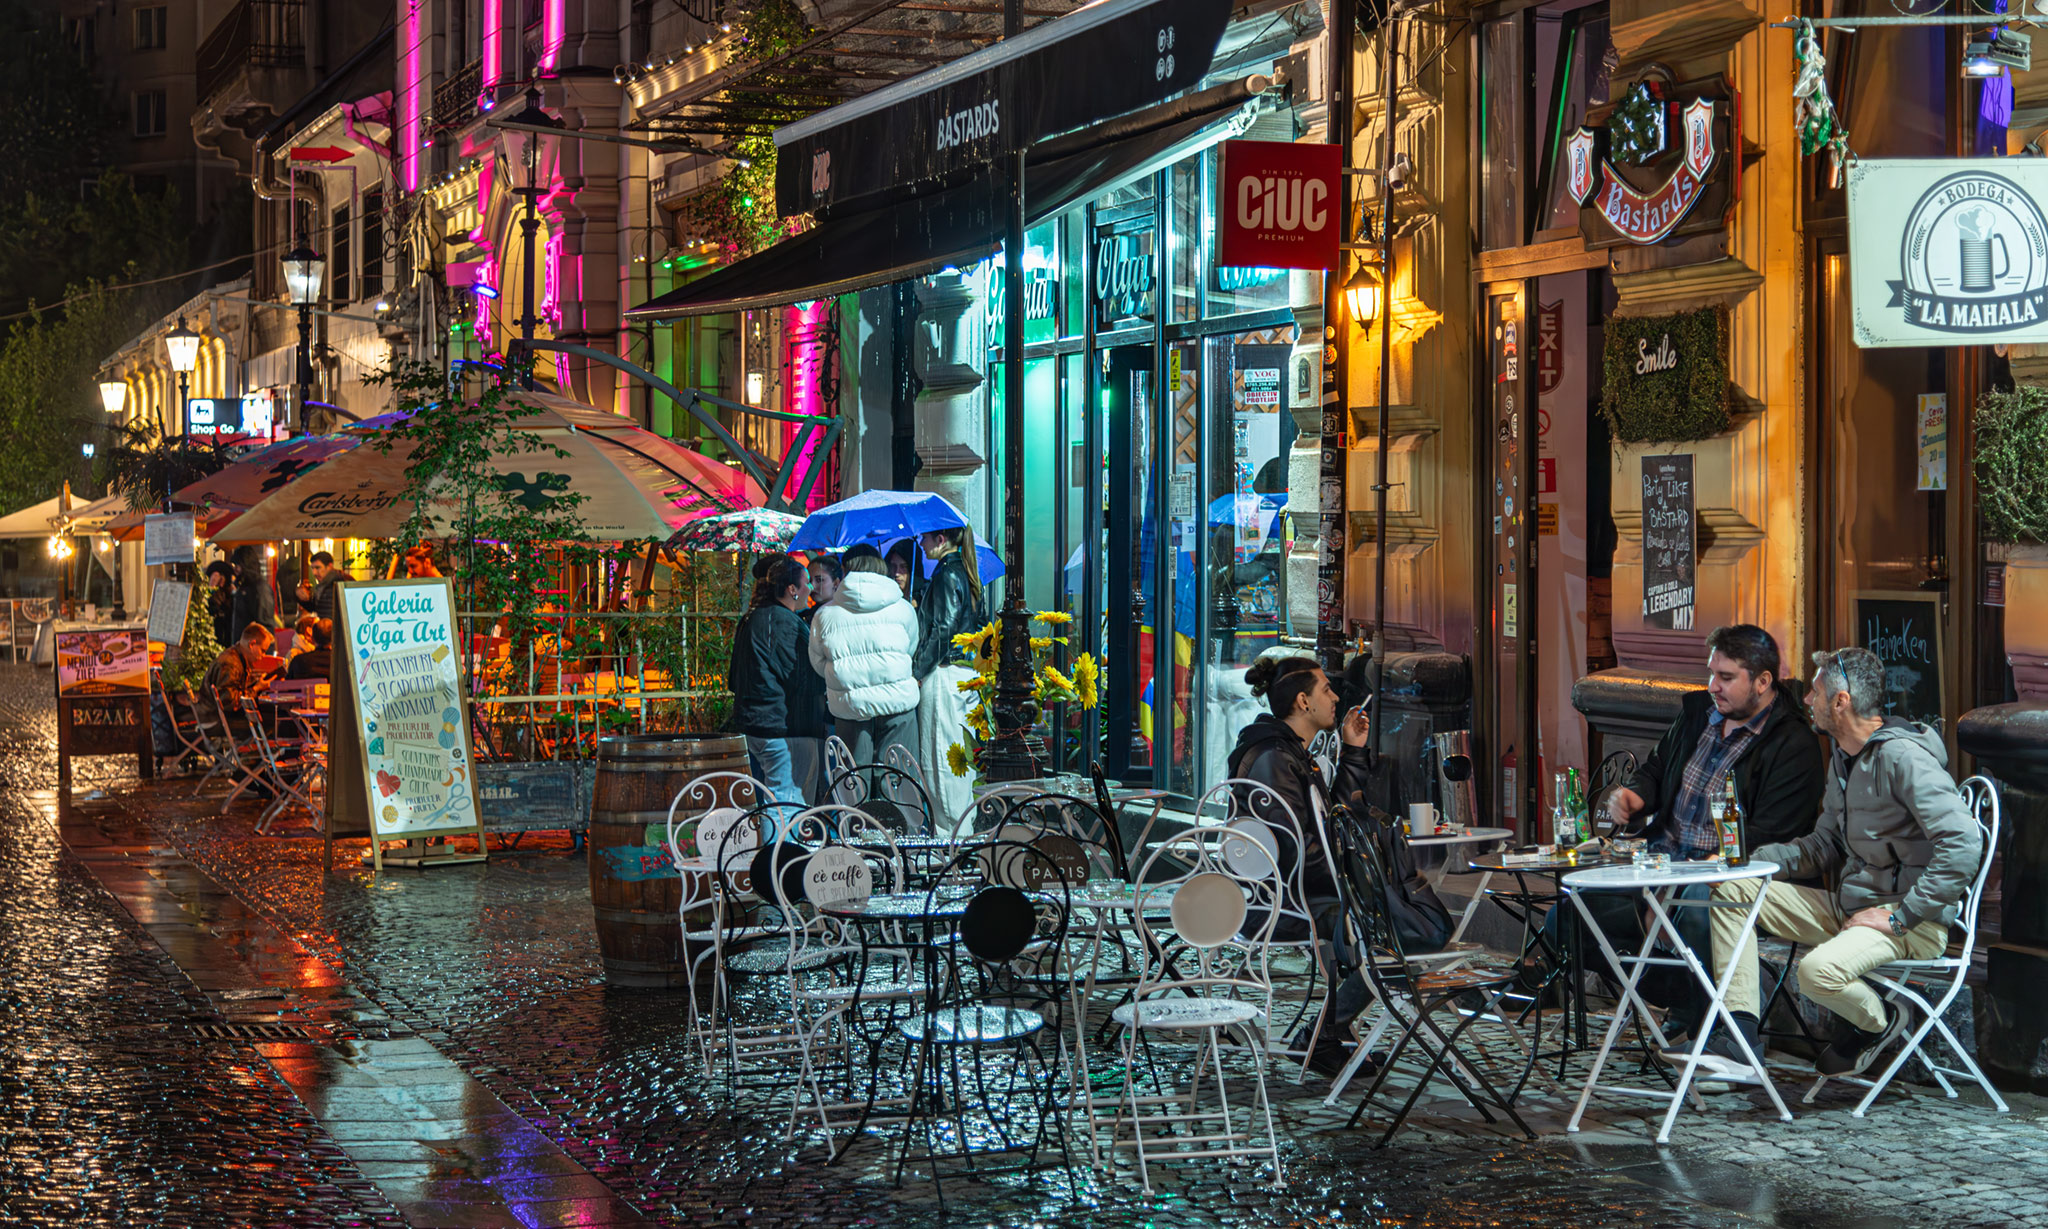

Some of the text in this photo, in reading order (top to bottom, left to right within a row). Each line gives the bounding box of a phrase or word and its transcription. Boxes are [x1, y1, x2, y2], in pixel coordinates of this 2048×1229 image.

[937, 98, 999, 151] BASTARDS
[1604, 174, 1693, 233] Bastards
[1945, 181, 2006, 204] BODEGA
[1257, 233, 1304, 242] PREMIUM
[1096, 234, 1150, 315] Olga
[986, 265, 1051, 347] Garia
[1540, 313, 1559, 387] EXIT
[1636, 333, 1678, 375] Smile
[1254, 370, 1276, 378] VOG
[190, 423, 235, 435] Shop Go
[1642, 474, 1663, 505] Party
[298, 490, 392, 518] Carlsberg
[1648, 506, 1690, 529] BASTARD
[296, 520, 351, 529] DENMARK
[361, 590, 434, 624] Galeria
[1643, 586, 1694, 616] A LEGENDARY
[1672, 605, 1695, 630] MIX
[356, 620, 447, 652] Olga Art
[370, 653, 434, 680] SUVENIRURI
[389, 674, 436, 698] CADOURI
[72, 708, 136, 726] BAZAAR
[382, 696, 440, 721] HANDMADE
[831, 864, 863, 888] caffè
